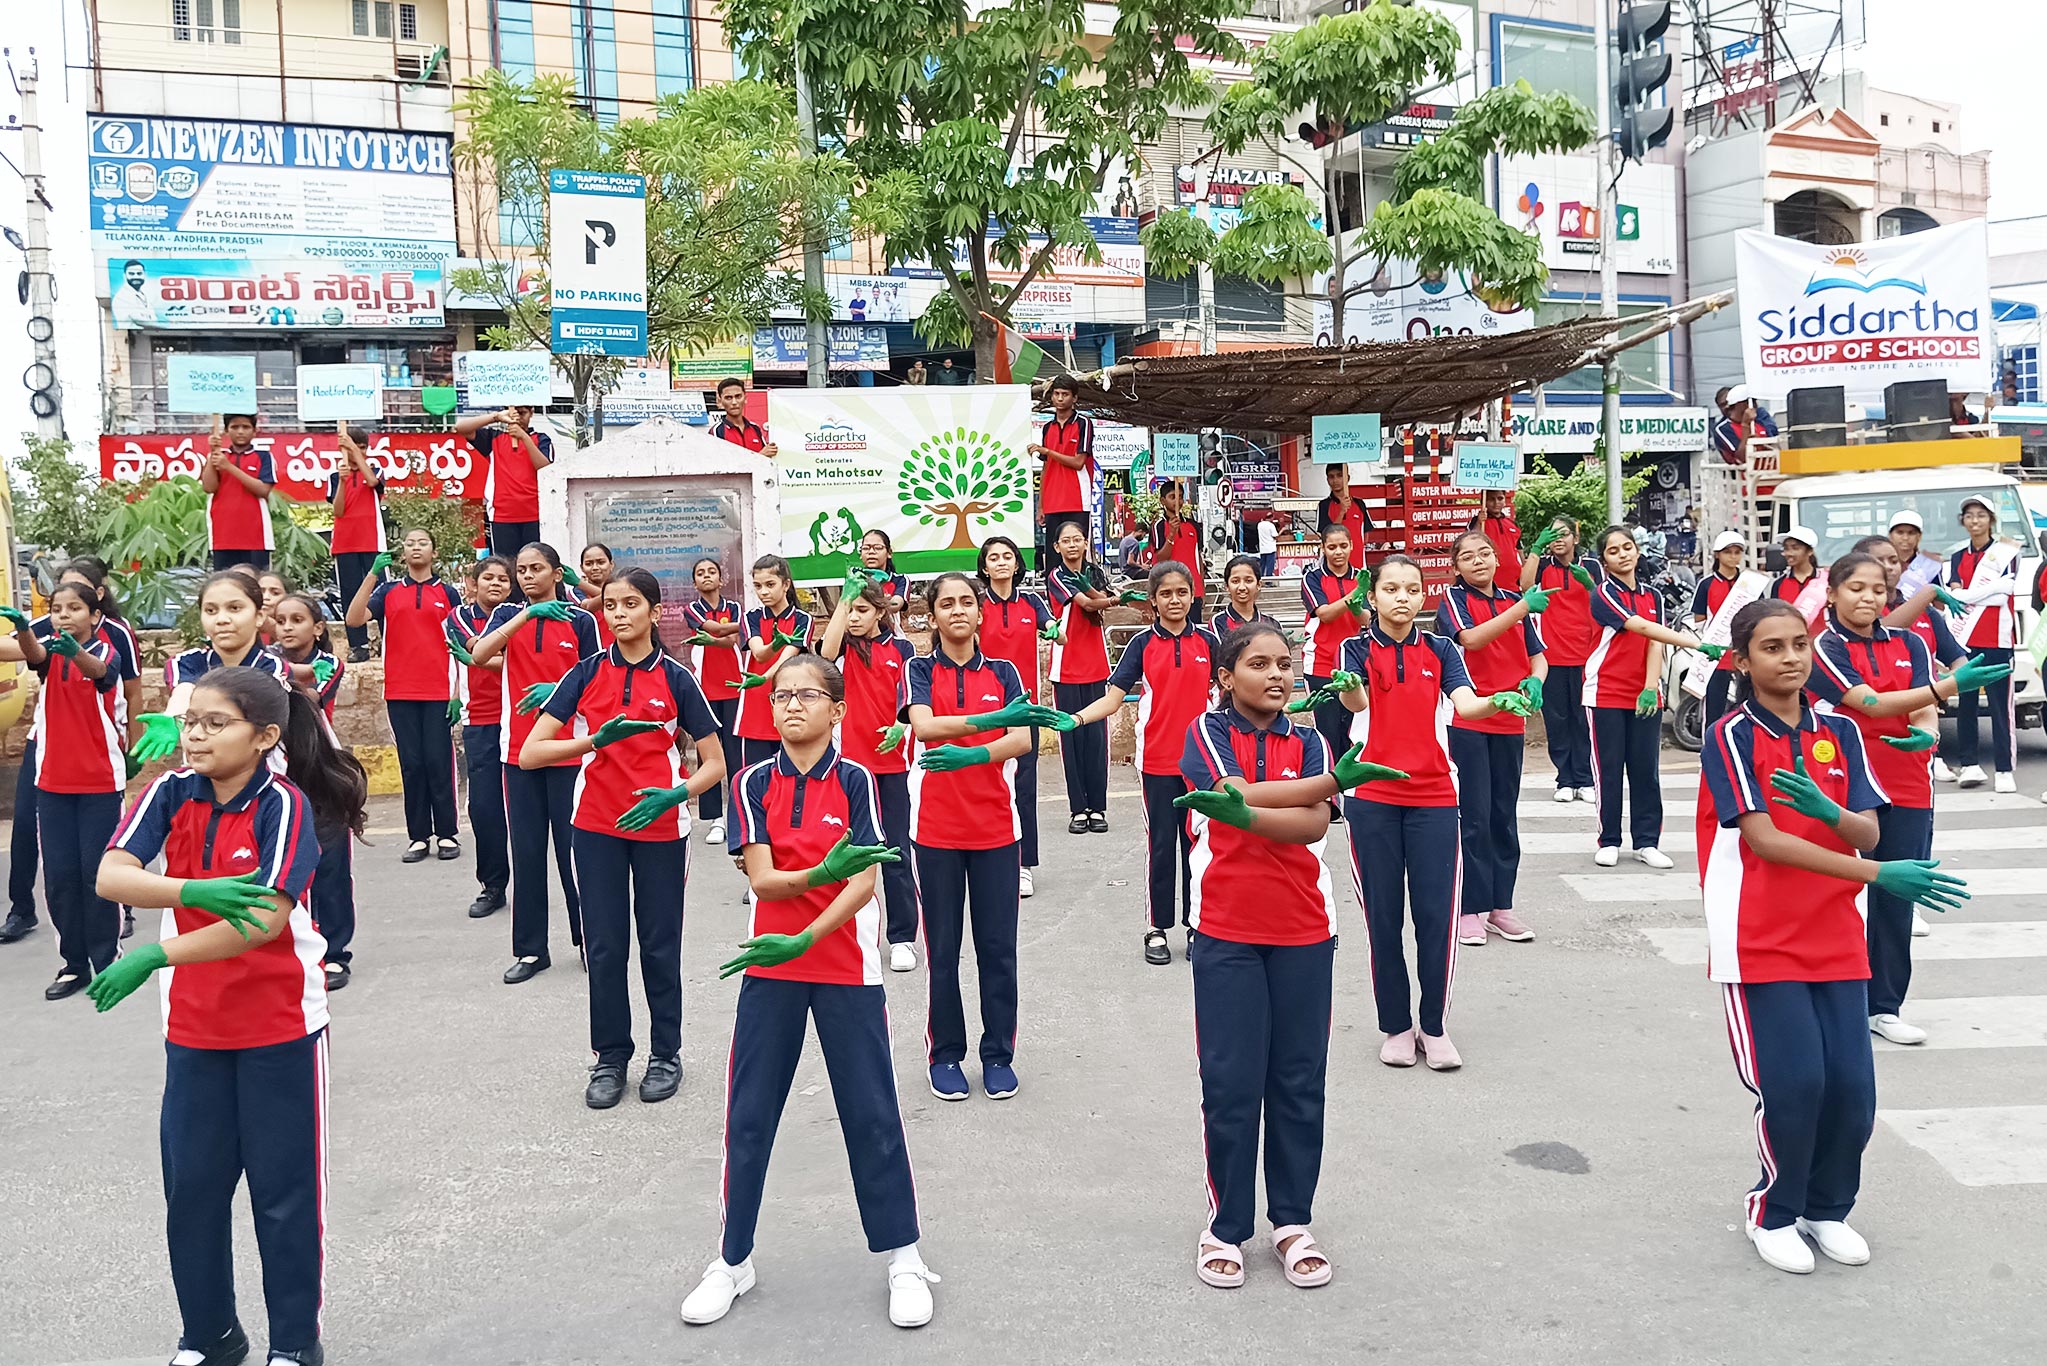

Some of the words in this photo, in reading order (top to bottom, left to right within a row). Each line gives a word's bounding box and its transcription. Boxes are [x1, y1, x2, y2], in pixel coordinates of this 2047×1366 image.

[1403, 104, 1437, 118] IGHT
[150, 119, 285, 165] NEWZEN
[293, 127, 450, 174] INFOTECH
[96, 166, 119, 184] 15
[571, 175, 608, 184] TRAFFIC
[610, 177, 642, 186] POLICE
[1207, 168, 1284, 187] SHAZAIB
[196, 210, 294, 221] PLAGIARISAM
[221, 220, 295, 230] Documentation
[1560, 208, 1636, 236] KIS
[105, 232, 165, 242] TELANGANA
[173, 235, 216, 244] ANDHRA
[219, 236, 263, 245] PRADESH
[1108, 257, 1123, 267] PVT
[1126, 258, 1141, 269] LTD
[160, 272, 301, 301] విరాట్
[849, 279, 873, 288] MBBS
[874, 279, 907, 289] Abroad!
[555, 289, 575, 299] NO
[580, 291, 643, 303] PARKING
[1018, 290, 1072, 303] ERPRISES
[1758, 299, 1978, 343] Siddartha
[577, 327, 604, 335] HDFC
[605, 328, 634, 336] BANK
[777, 326, 833, 341] COMPR
[836, 326, 865, 341] ZONE
[784, 342, 808, 350] COMPU
[1762, 345, 1838, 365] GROUP
[1843, 342, 1873, 358] OF
[1878, 339, 1979, 358] SCHOOLS
[1845, 362, 1897, 371] INSPIRE
[1527, 419, 1566, 436] CARE
[1568, 421, 1595, 435] AND
[1636, 418, 1705, 434] MEDICALS
[805, 432, 866, 443] Siddartha
[1162, 438, 1176, 449] One
[1176, 438, 1190, 449] Tree
[1093, 444, 1145, 452] UNICATIONS
[1162, 450, 1176, 461] One
[1176, 450, 1191, 462] Hope
[1162, 461, 1176, 472] One
[1176, 461, 1196, 472] Future
[1240, 465, 1269, 473] SRR
[1459, 458, 1476, 469] Each
[1499, 460, 1514, 470] Plant
[785, 469, 811, 479] Van
[816, 467, 883, 479] Mahotsav
[1412, 486, 1440, 497] FASTER
[1441, 486, 1459, 495] WILL
[1412, 512, 1431, 522] OBEY
[1432, 511, 1452, 520] ROAD
[1413, 533, 1442, 544] SAFETY
[1443, 532, 1461, 542] FIRS
[1279, 545, 1318, 557] HAVEMO
[1436, 557, 1452, 567] EXPE
